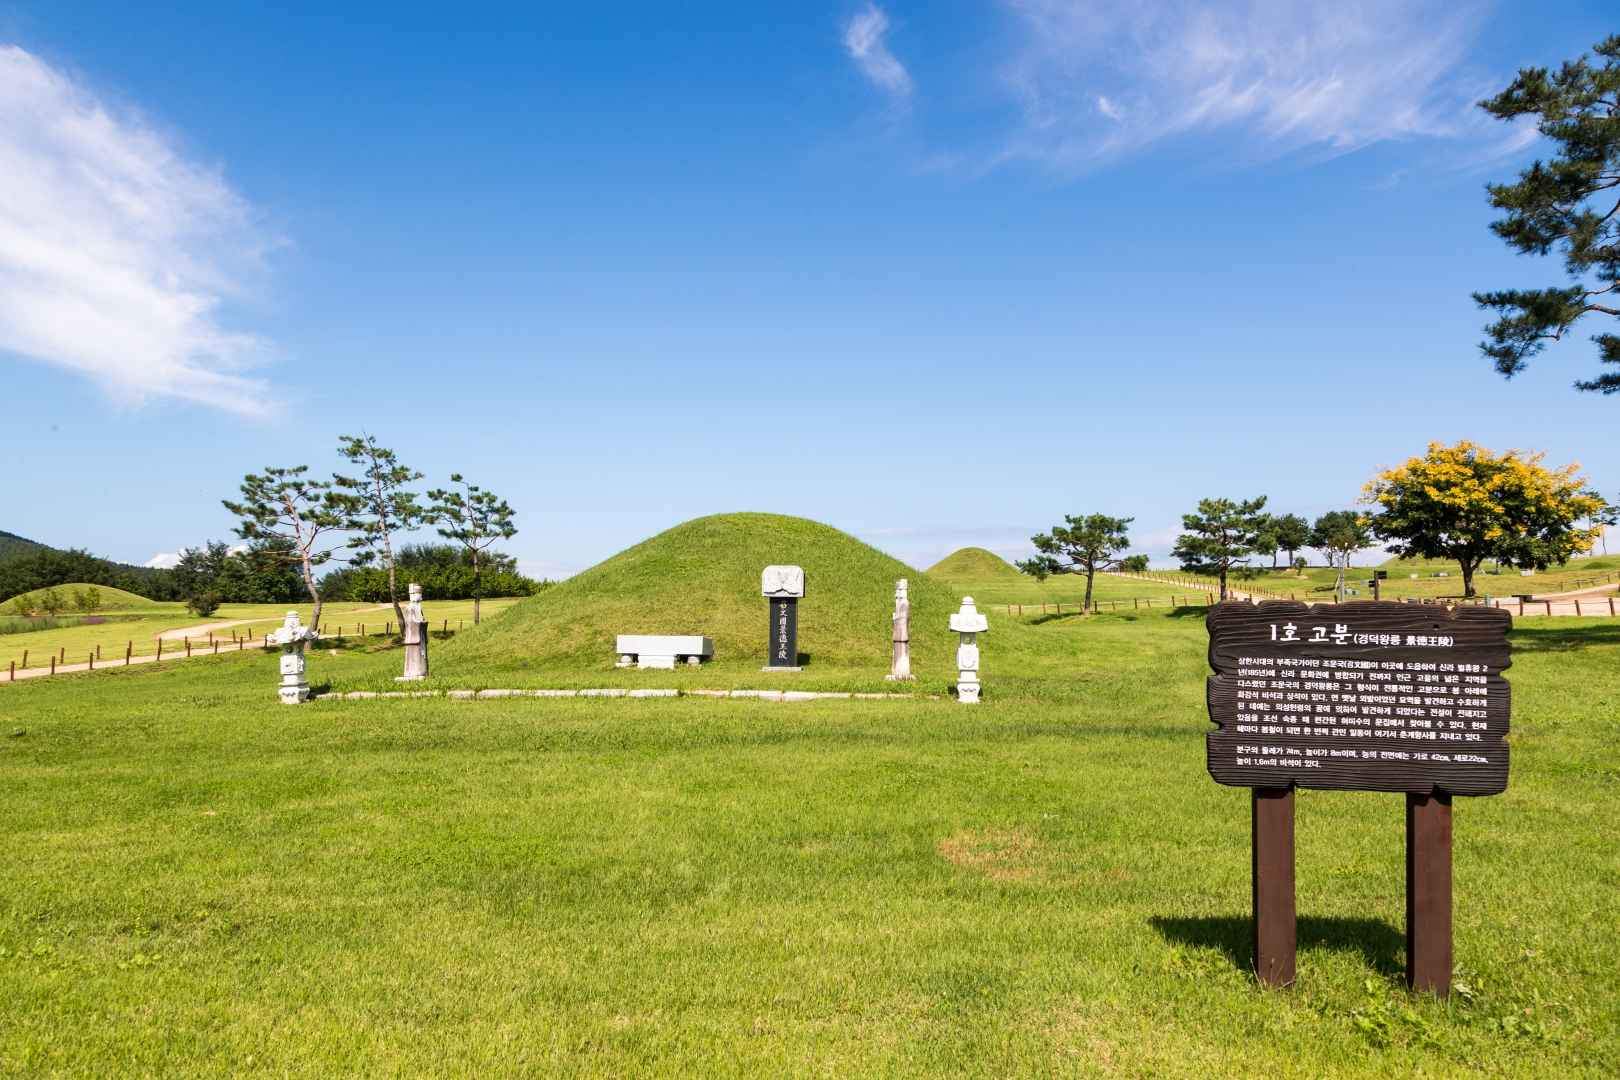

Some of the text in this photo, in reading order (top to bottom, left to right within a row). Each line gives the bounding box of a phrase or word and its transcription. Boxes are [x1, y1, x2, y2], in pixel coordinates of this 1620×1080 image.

[1270, 622, 1301, 642] 1호
[1307, 624, 1352, 645] 고분
[1482, 665, 1488, 673] 2
